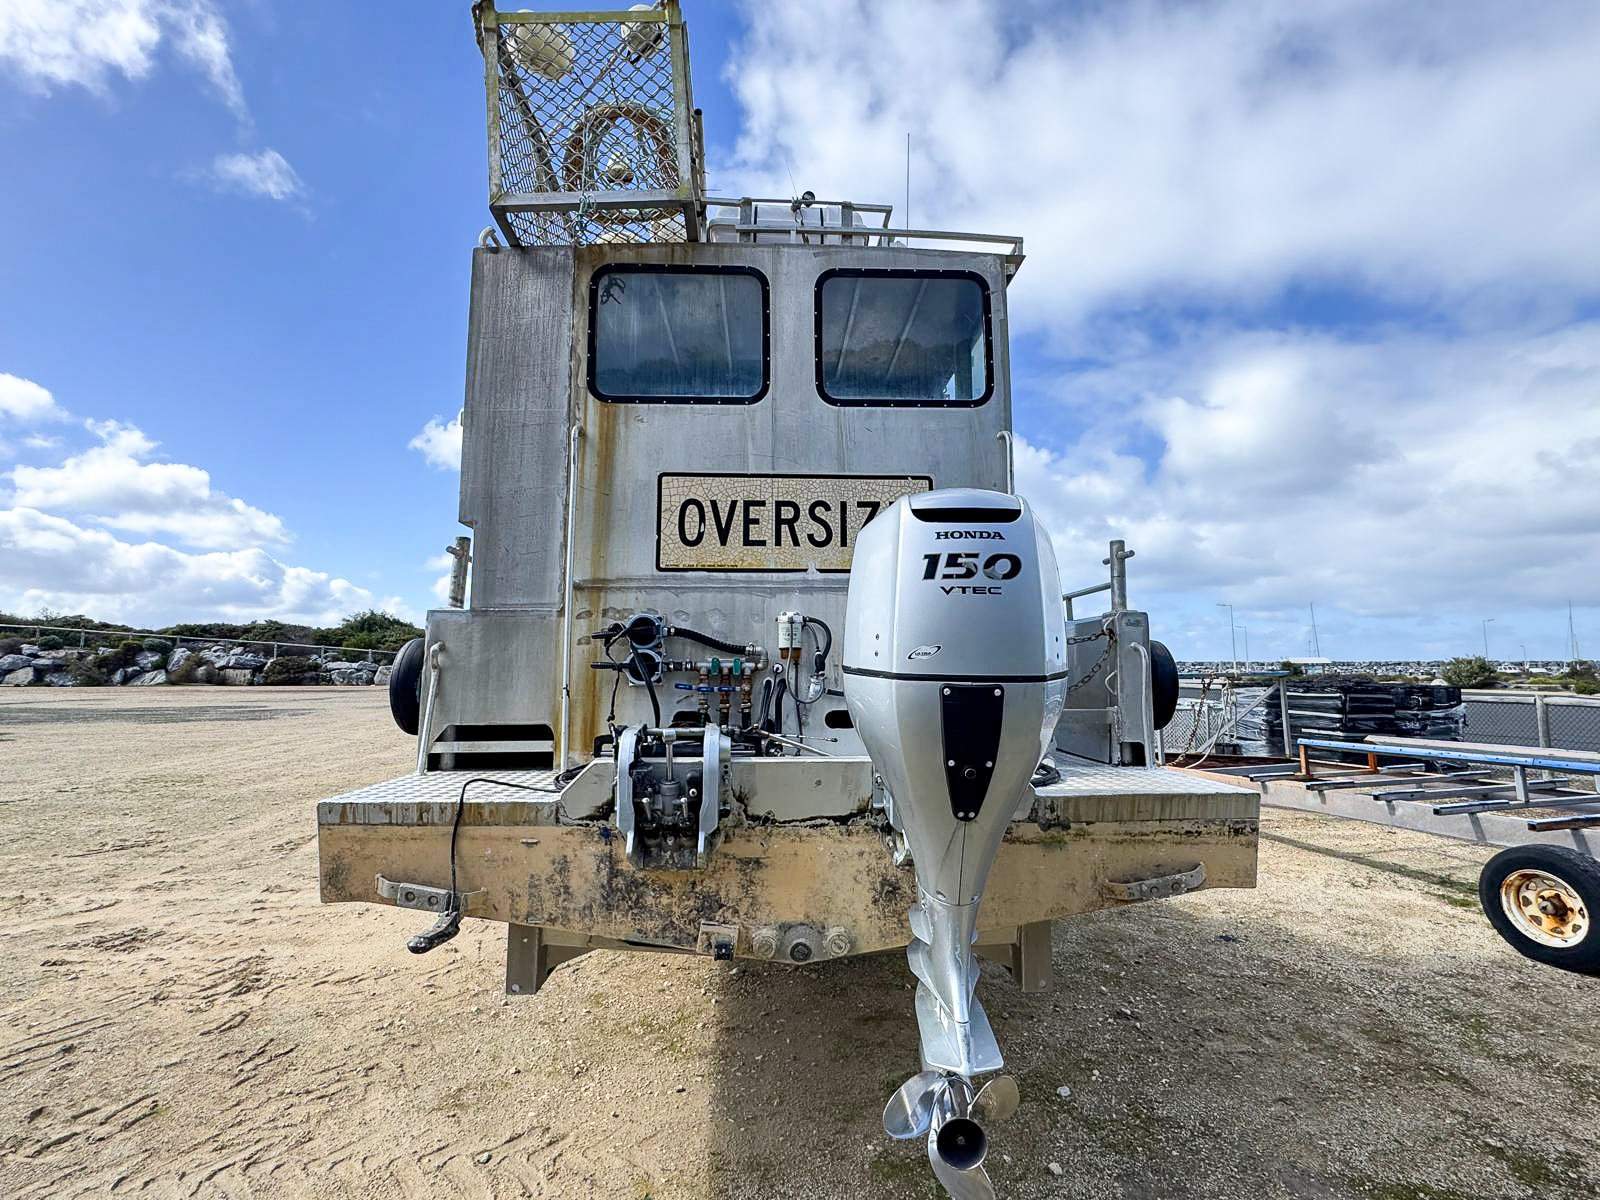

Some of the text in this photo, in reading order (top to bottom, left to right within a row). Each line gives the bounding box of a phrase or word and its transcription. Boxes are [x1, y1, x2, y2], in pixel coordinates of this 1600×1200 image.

[677, 498, 897, 548] OVERSIZ
[935, 530, 1006, 541] HONDA
[922, 553, 1023, 581] 150
[940, 586, 1003, 596] VTEC
